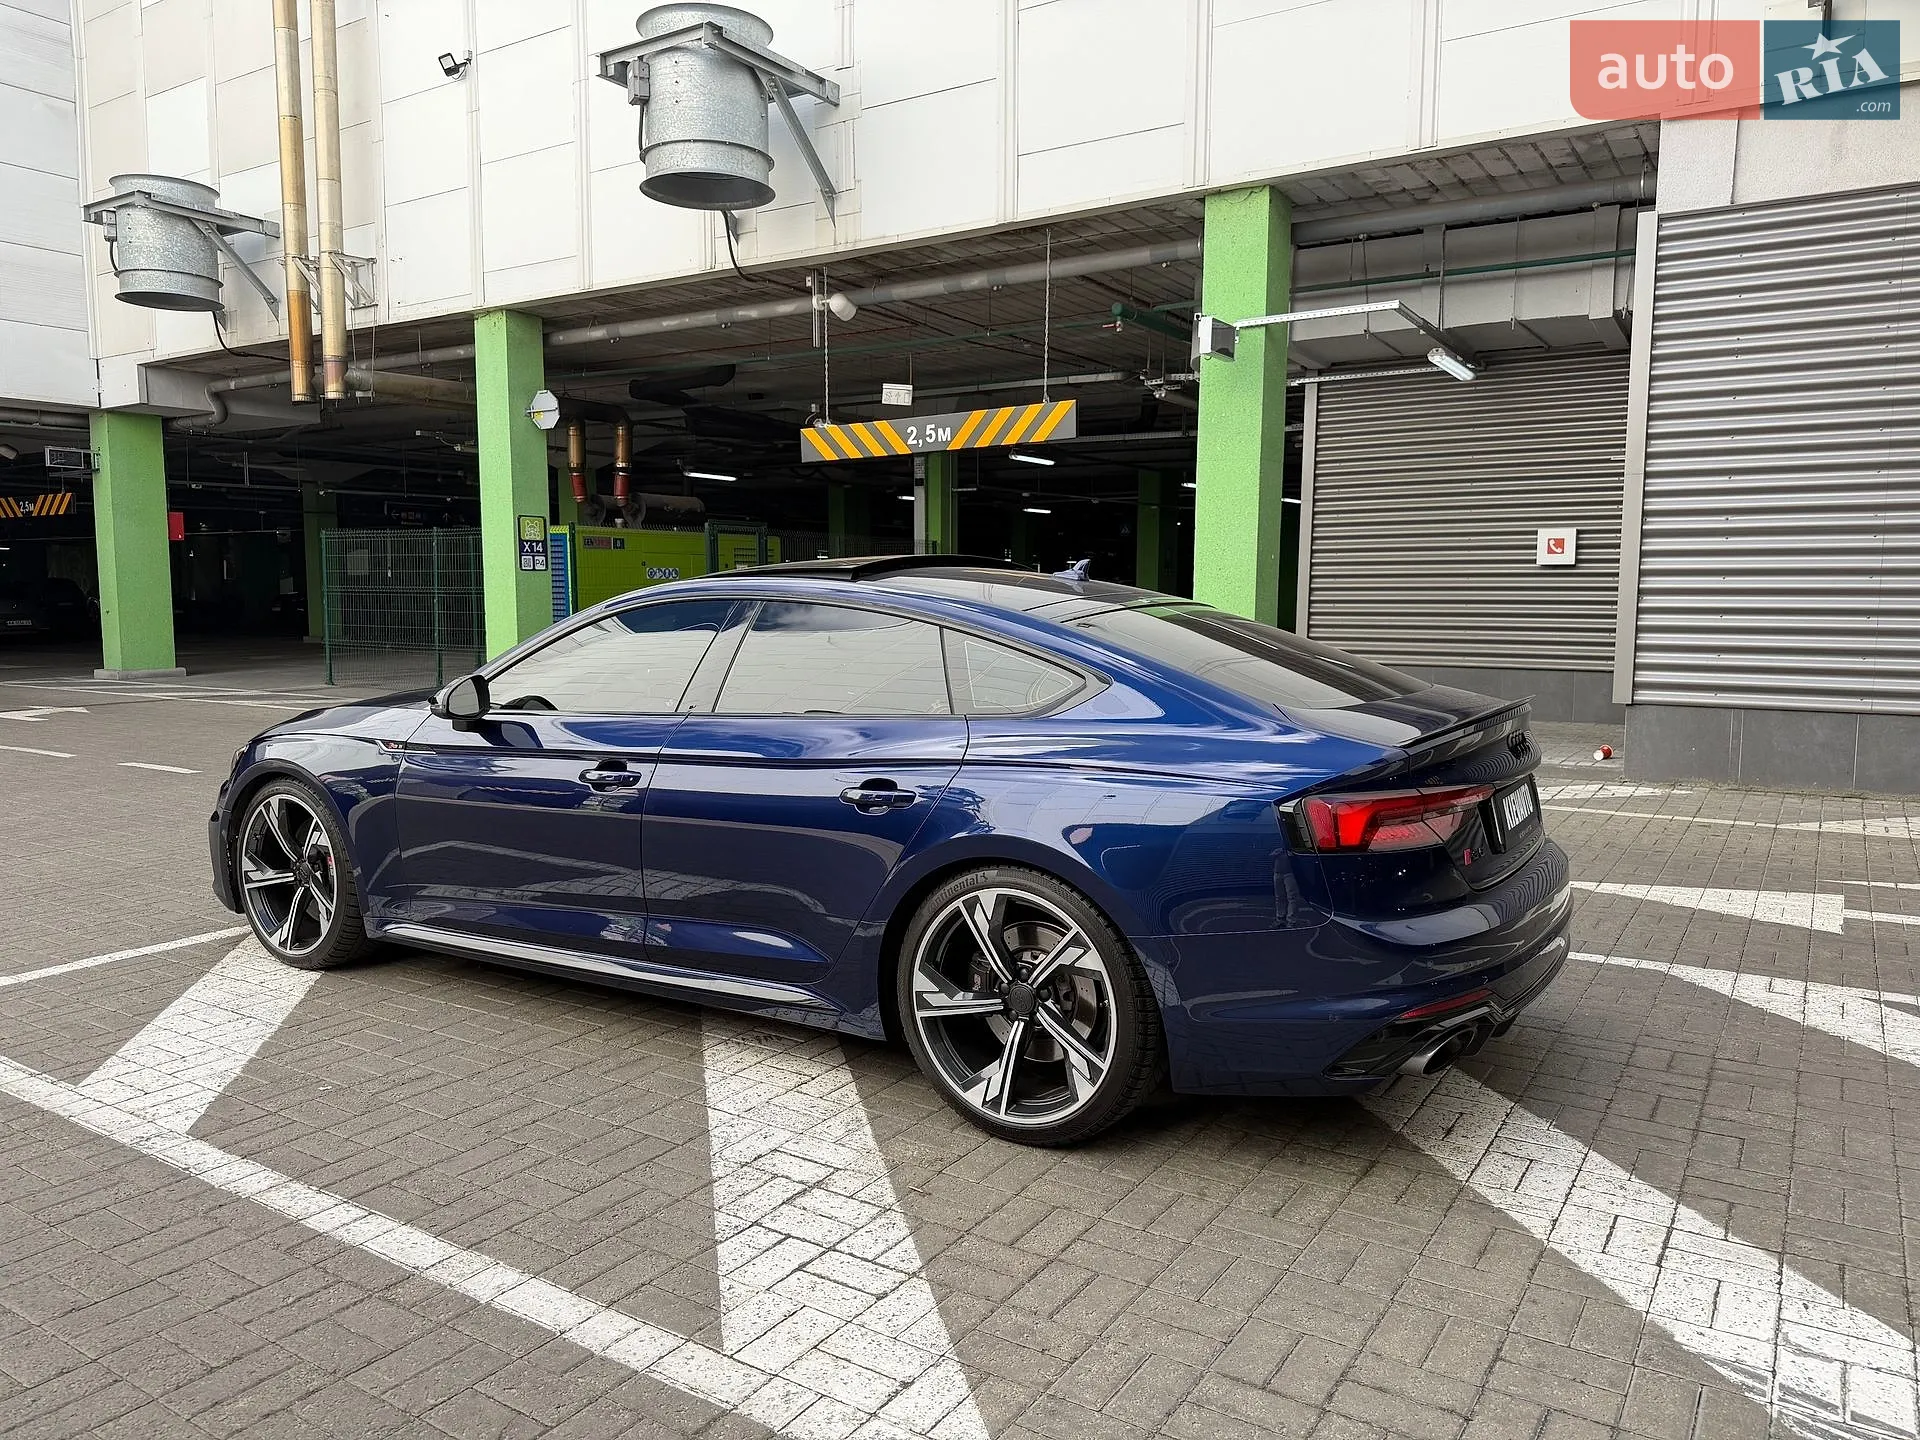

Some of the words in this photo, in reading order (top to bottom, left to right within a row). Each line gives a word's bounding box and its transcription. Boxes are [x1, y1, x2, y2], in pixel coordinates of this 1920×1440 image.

[523, 541, 531, 553] X
[531, 541, 543, 553] 14
[535, 557, 545, 567] P4
